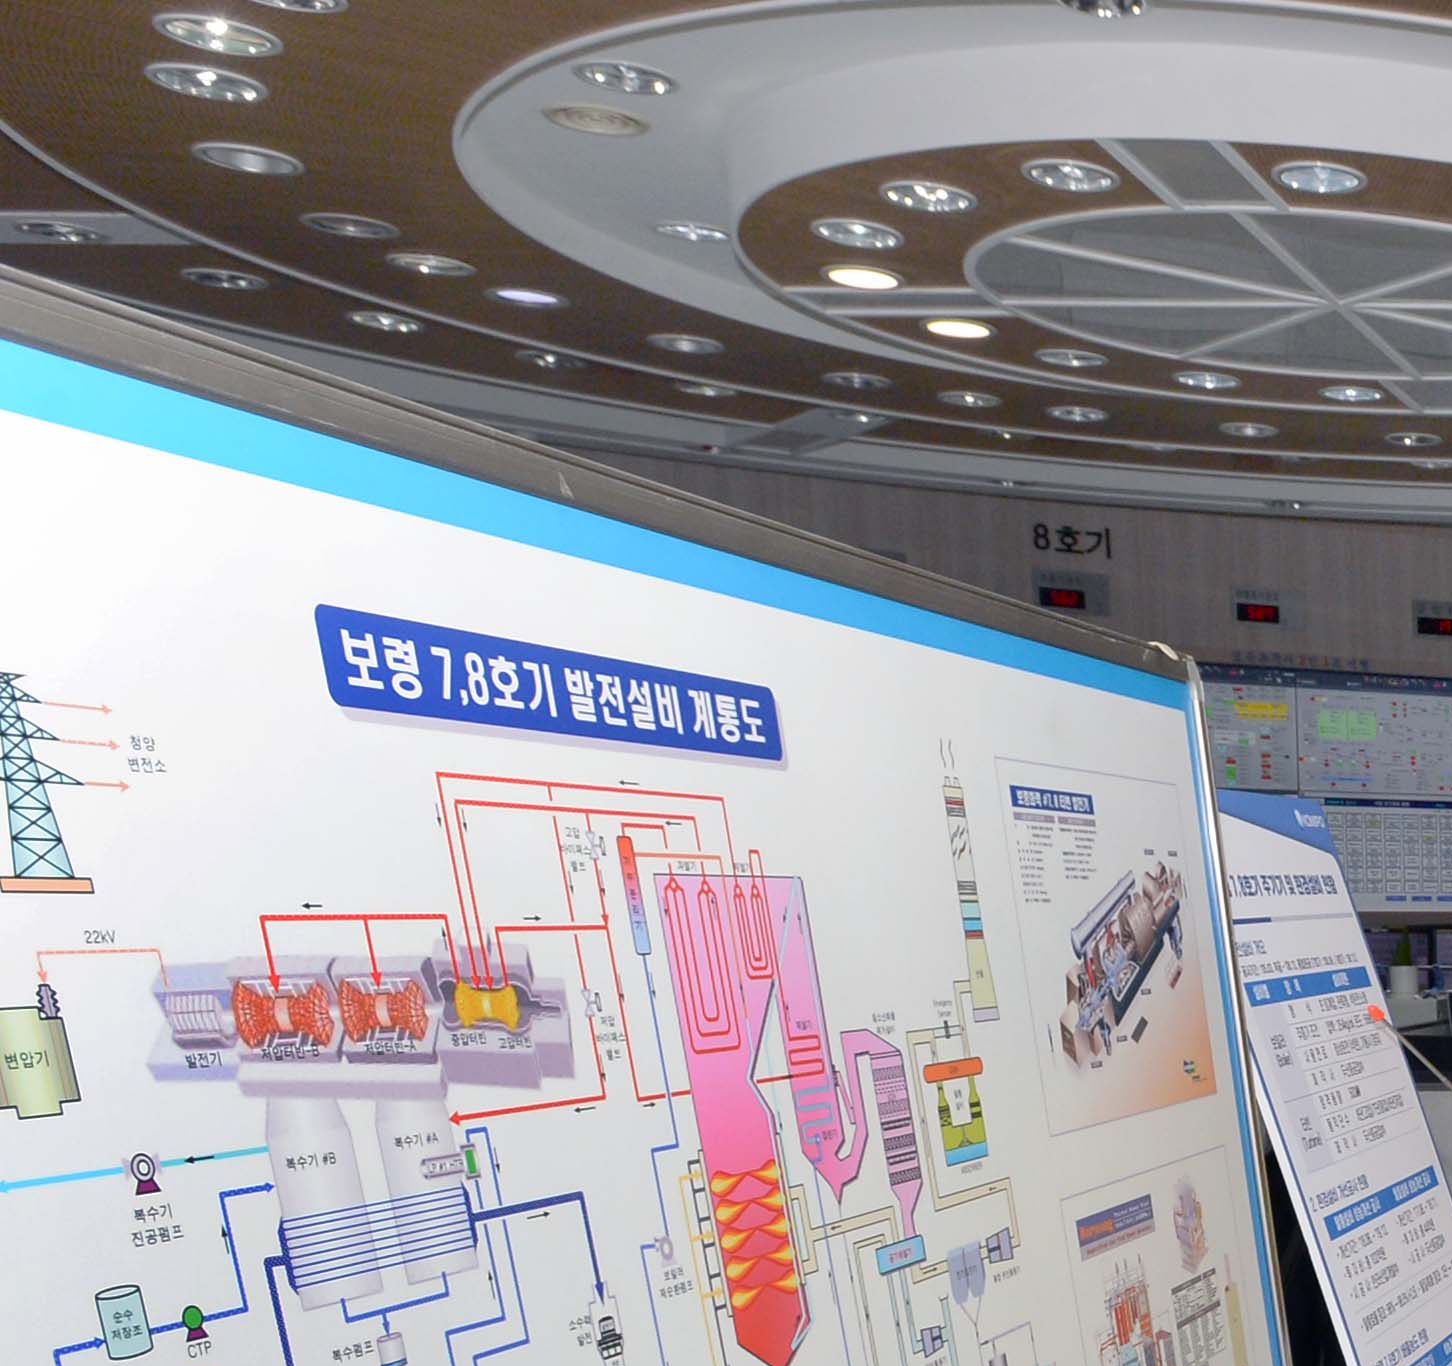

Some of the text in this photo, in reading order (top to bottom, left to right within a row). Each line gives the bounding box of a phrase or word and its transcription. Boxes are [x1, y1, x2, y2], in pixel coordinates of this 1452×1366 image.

[1032, 523, 1113, 559] 8호기
[339, 627, 768, 744] 보령 7,8호기 발전설비 계통도
[129, 734, 157, 754] 청양
[126, 754, 168, 775] 변전소
[83, 929, 116, 945] 22kV
[364, 1040, 418, 1057] 저압터빈-A
[450, 1032, 488, 1048] 중압터빈
[3, 1051, 51, 1071] 변압기
[184, 1052, 224, 1070] 발전기
[260, 1044, 321, 1061] 저압터빈-B
[393, 1134, 424, 1149] 복수기
[286, 1152, 338, 1171] 복수기 #B
[133, 1202, 174, 1223] 복수기
[130, 1224, 185, 1248] 진공펌프
[112, 1309, 134, 1325] 순수
[110, 1324, 144, 1342] 저장조
[187, 1340, 213, 1359] CTP
[331, 1340, 375, 1363] 복수펌프
